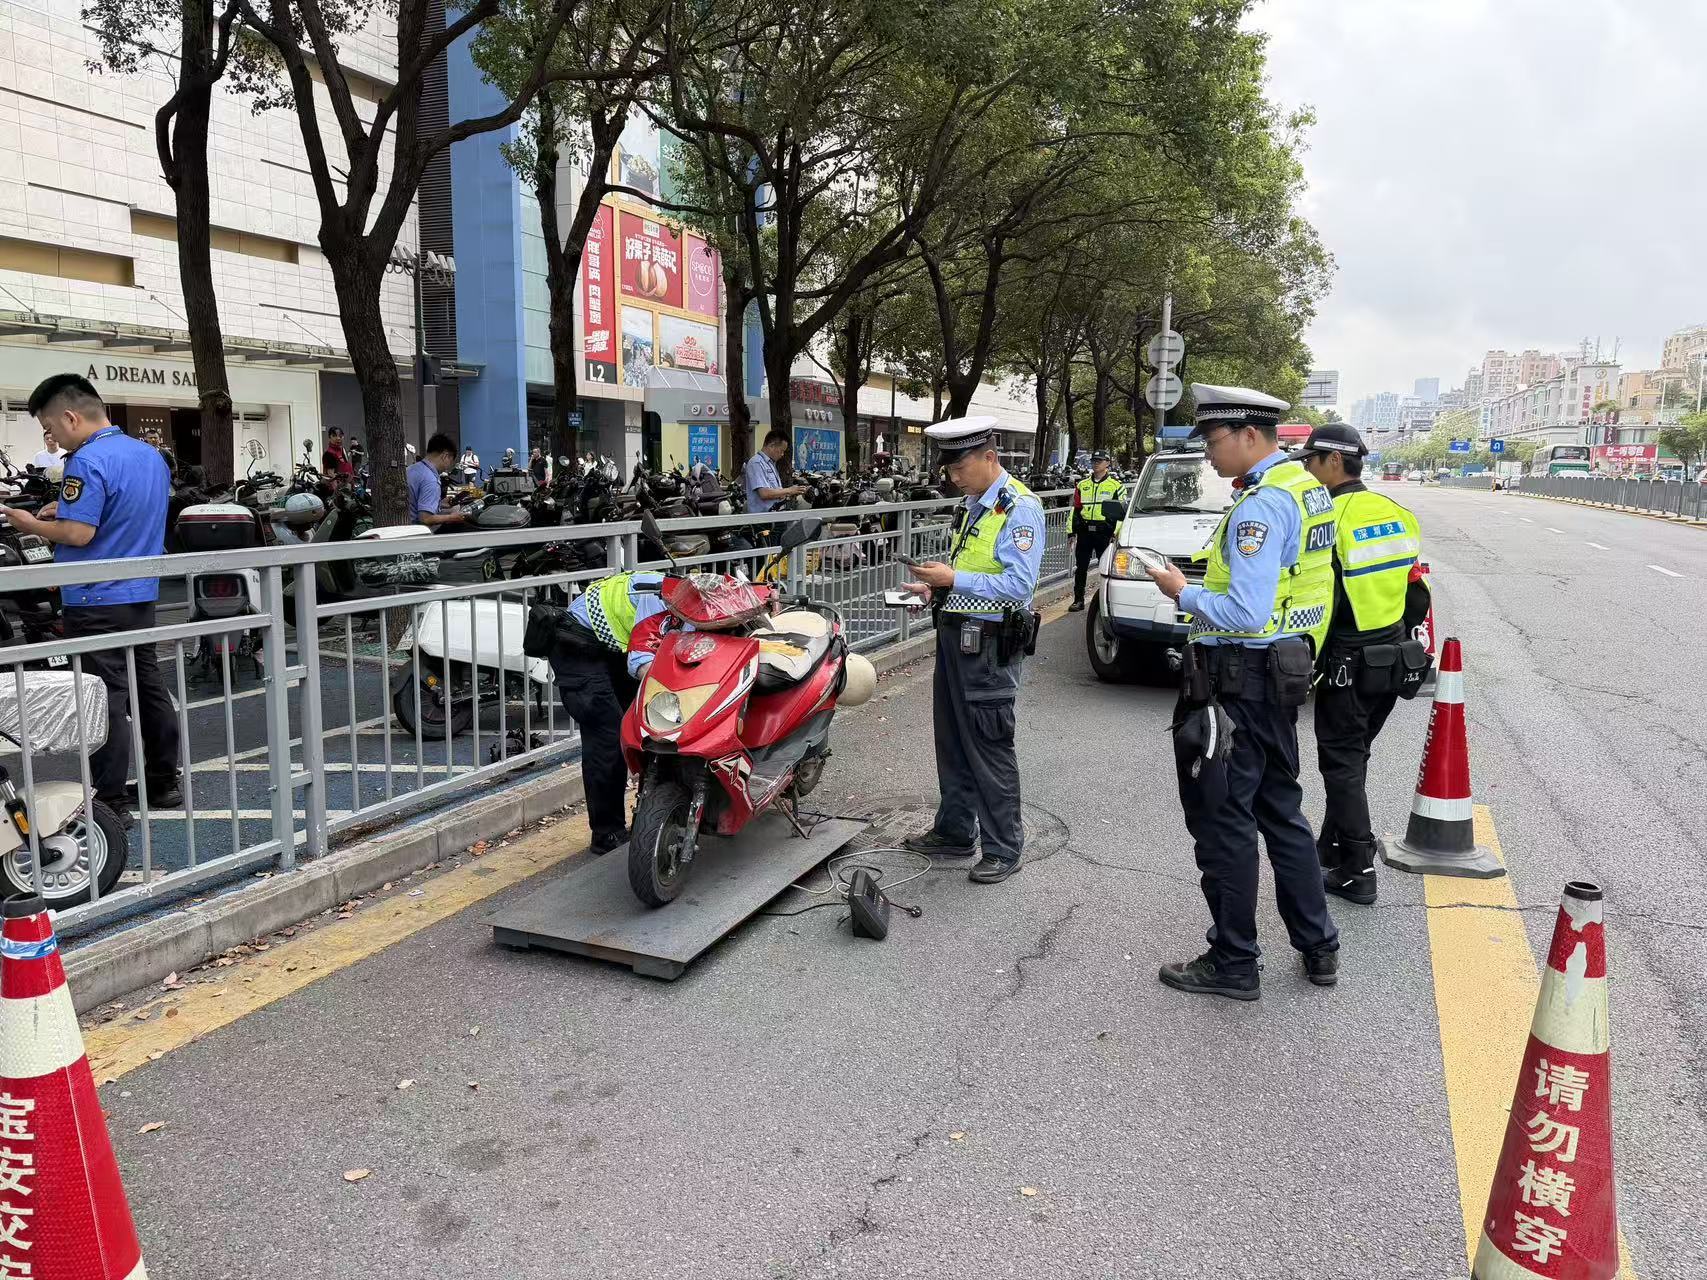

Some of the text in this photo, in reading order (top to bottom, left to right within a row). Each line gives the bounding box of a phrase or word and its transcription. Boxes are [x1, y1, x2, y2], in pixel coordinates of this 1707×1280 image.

[87, 363, 99, 380] A
[106, 365, 165, 385] DREAM
[589, 363, 605, 382] L2
[1511, 1058, 1590, 1264] 请勿横穿
